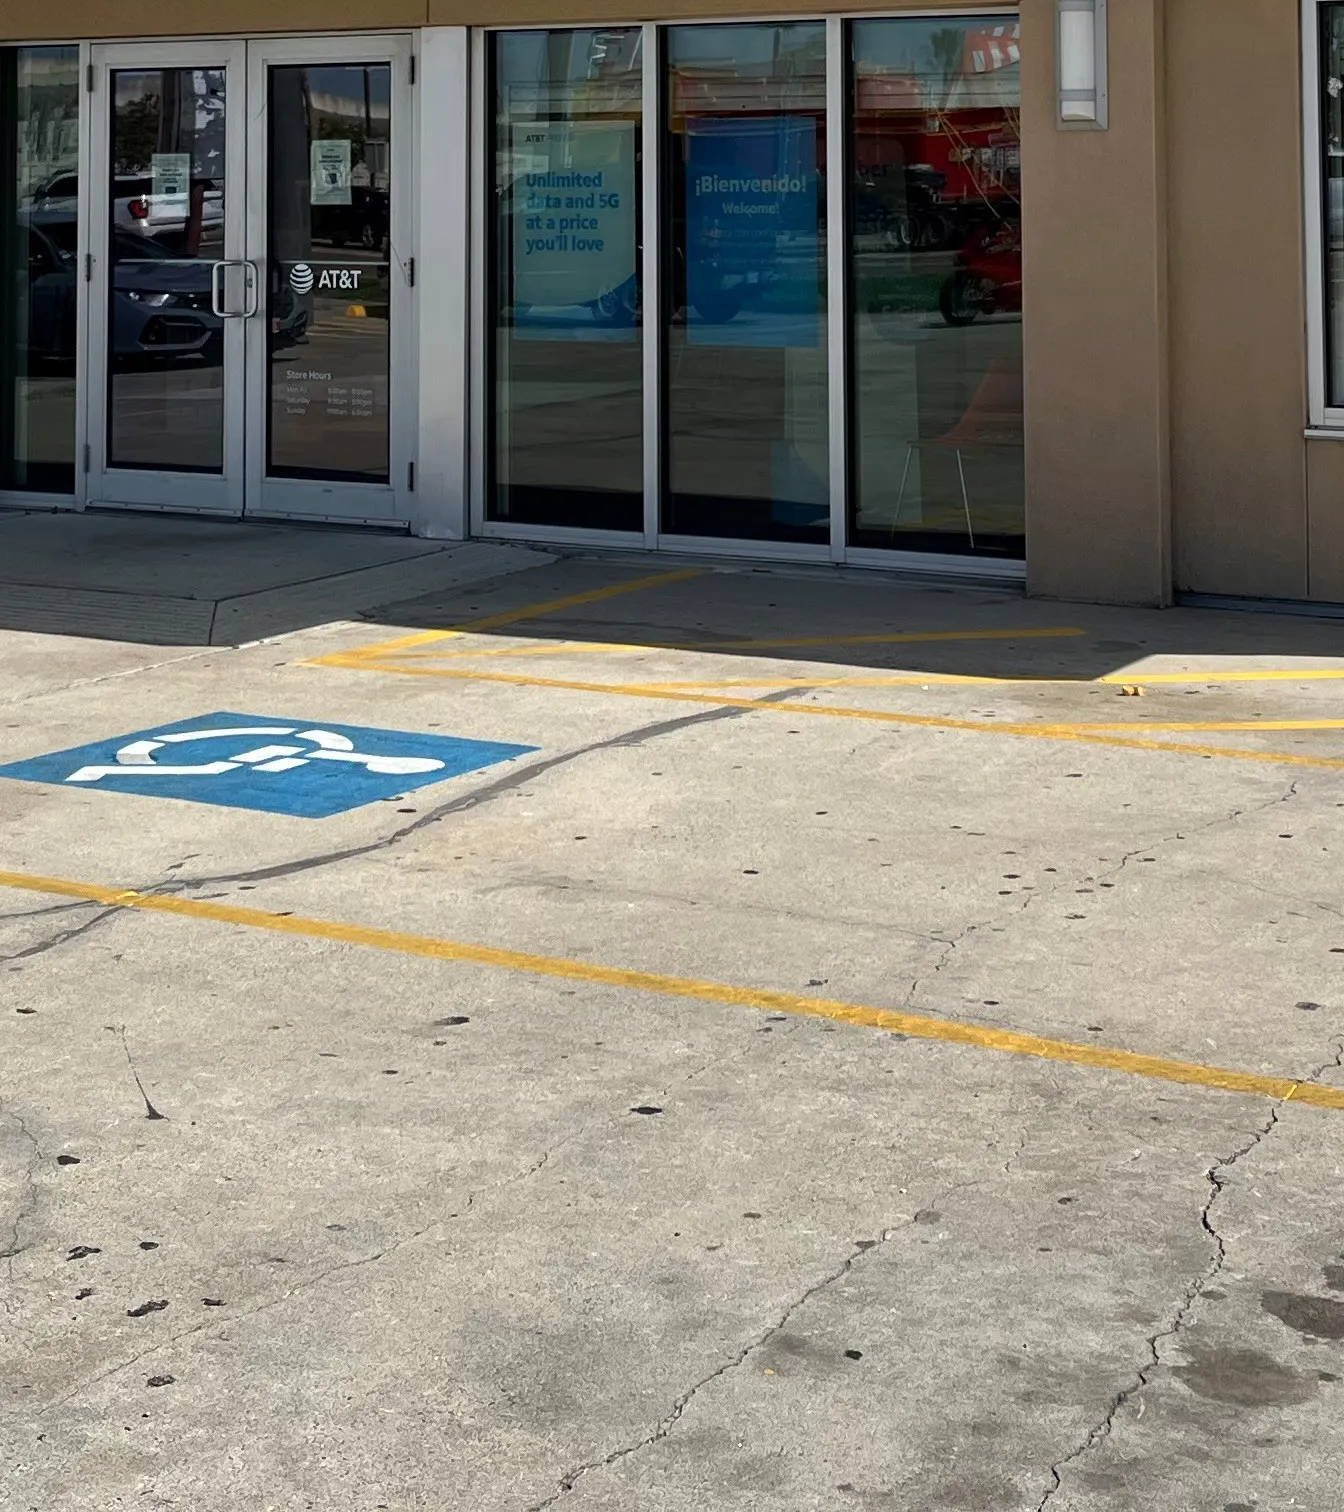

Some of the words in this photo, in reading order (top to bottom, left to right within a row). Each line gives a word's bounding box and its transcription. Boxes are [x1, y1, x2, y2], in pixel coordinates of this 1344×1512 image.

[525, 134, 546, 143] AT&T
[525, 171, 602, 188] Unlimited
[695, 174, 807, 197] ¡Bienvenido!
[527, 193, 561, 209] data
[566, 193, 594, 209] and
[599, 193, 620, 209] 5G
[722, 202, 780, 215] Welcome!
[525, 216, 543, 230] at
[546, 219, 556, 230] a
[560, 214, 598, 234] price
[525, 235, 568, 255] you'll
[572, 235, 604, 251] love
[318, 269, 362, 289] AT&T
[286, 370, 307, 380] Store
[308, 371, 332, 381] Hours
